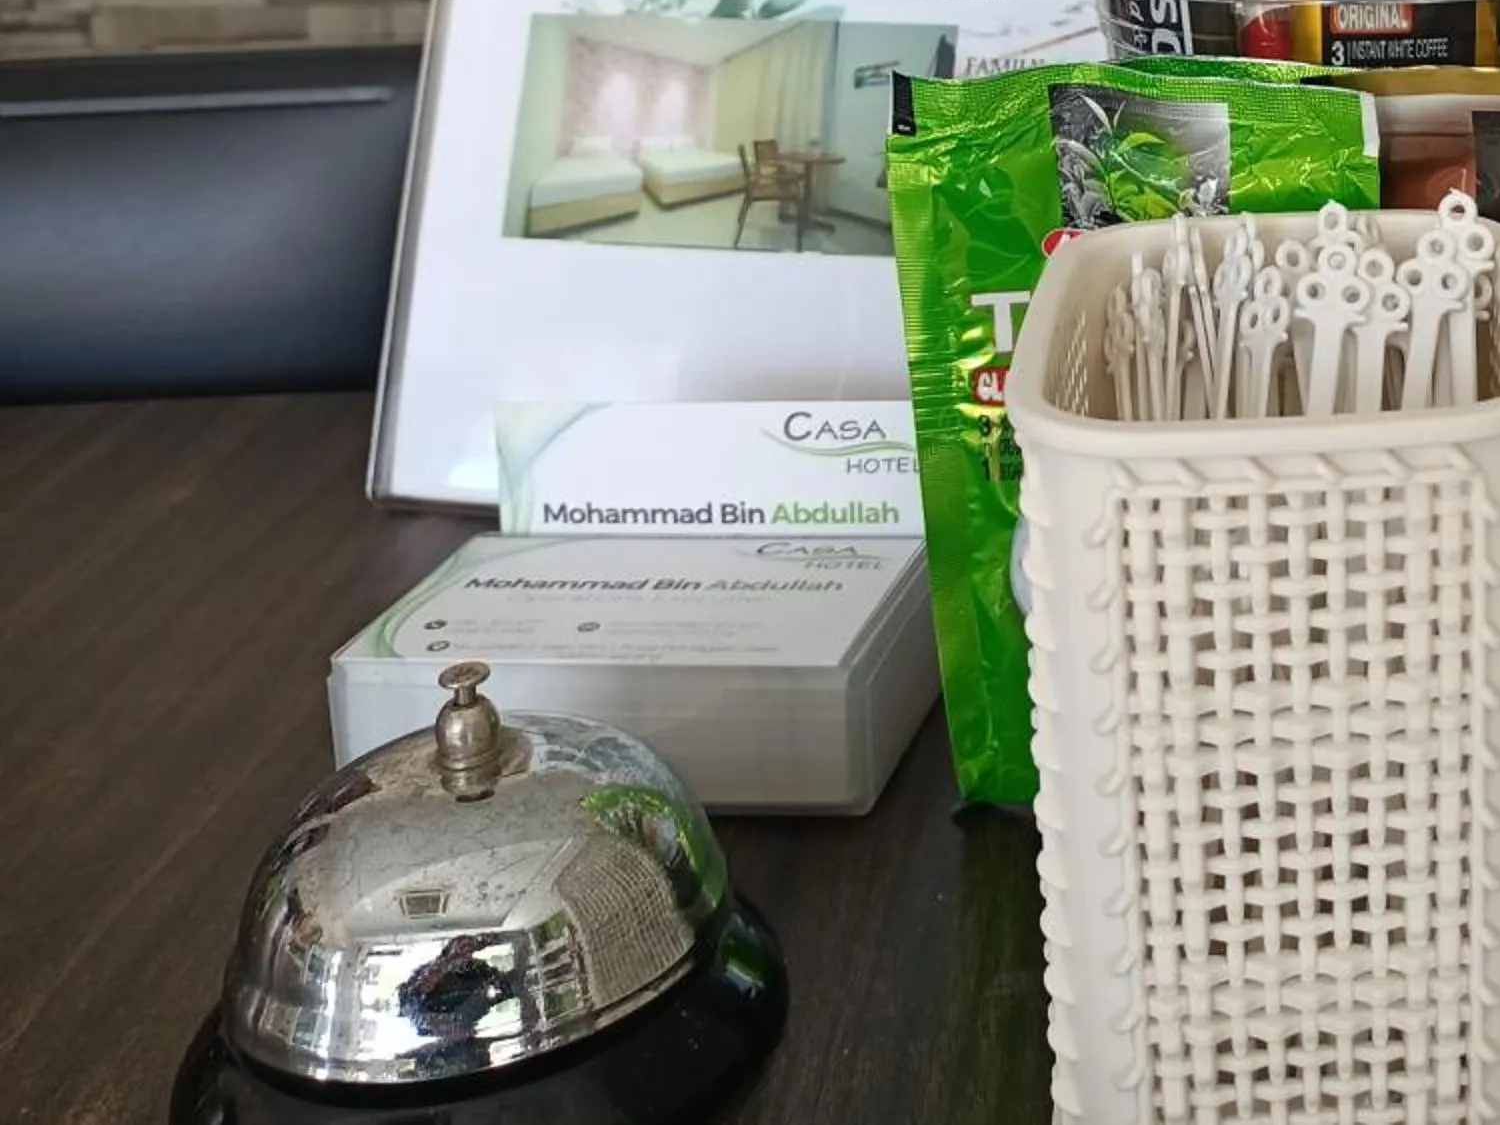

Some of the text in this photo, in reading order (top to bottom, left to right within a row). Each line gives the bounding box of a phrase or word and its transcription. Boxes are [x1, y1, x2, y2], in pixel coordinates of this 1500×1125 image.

[1337, 1, 1409, 30] ORIGINAL
[783, 411, 887, 441] CASA
[846, 457, 920, 475] HOTEL
[543, 501, 900, 525] Mohammad Bin Abdullah
[755, 541, 859, 557] CASA
[801, 560, 886, 571] HOTEL
[463, 577, 844, 593] Mohammad Bin Abdullah
